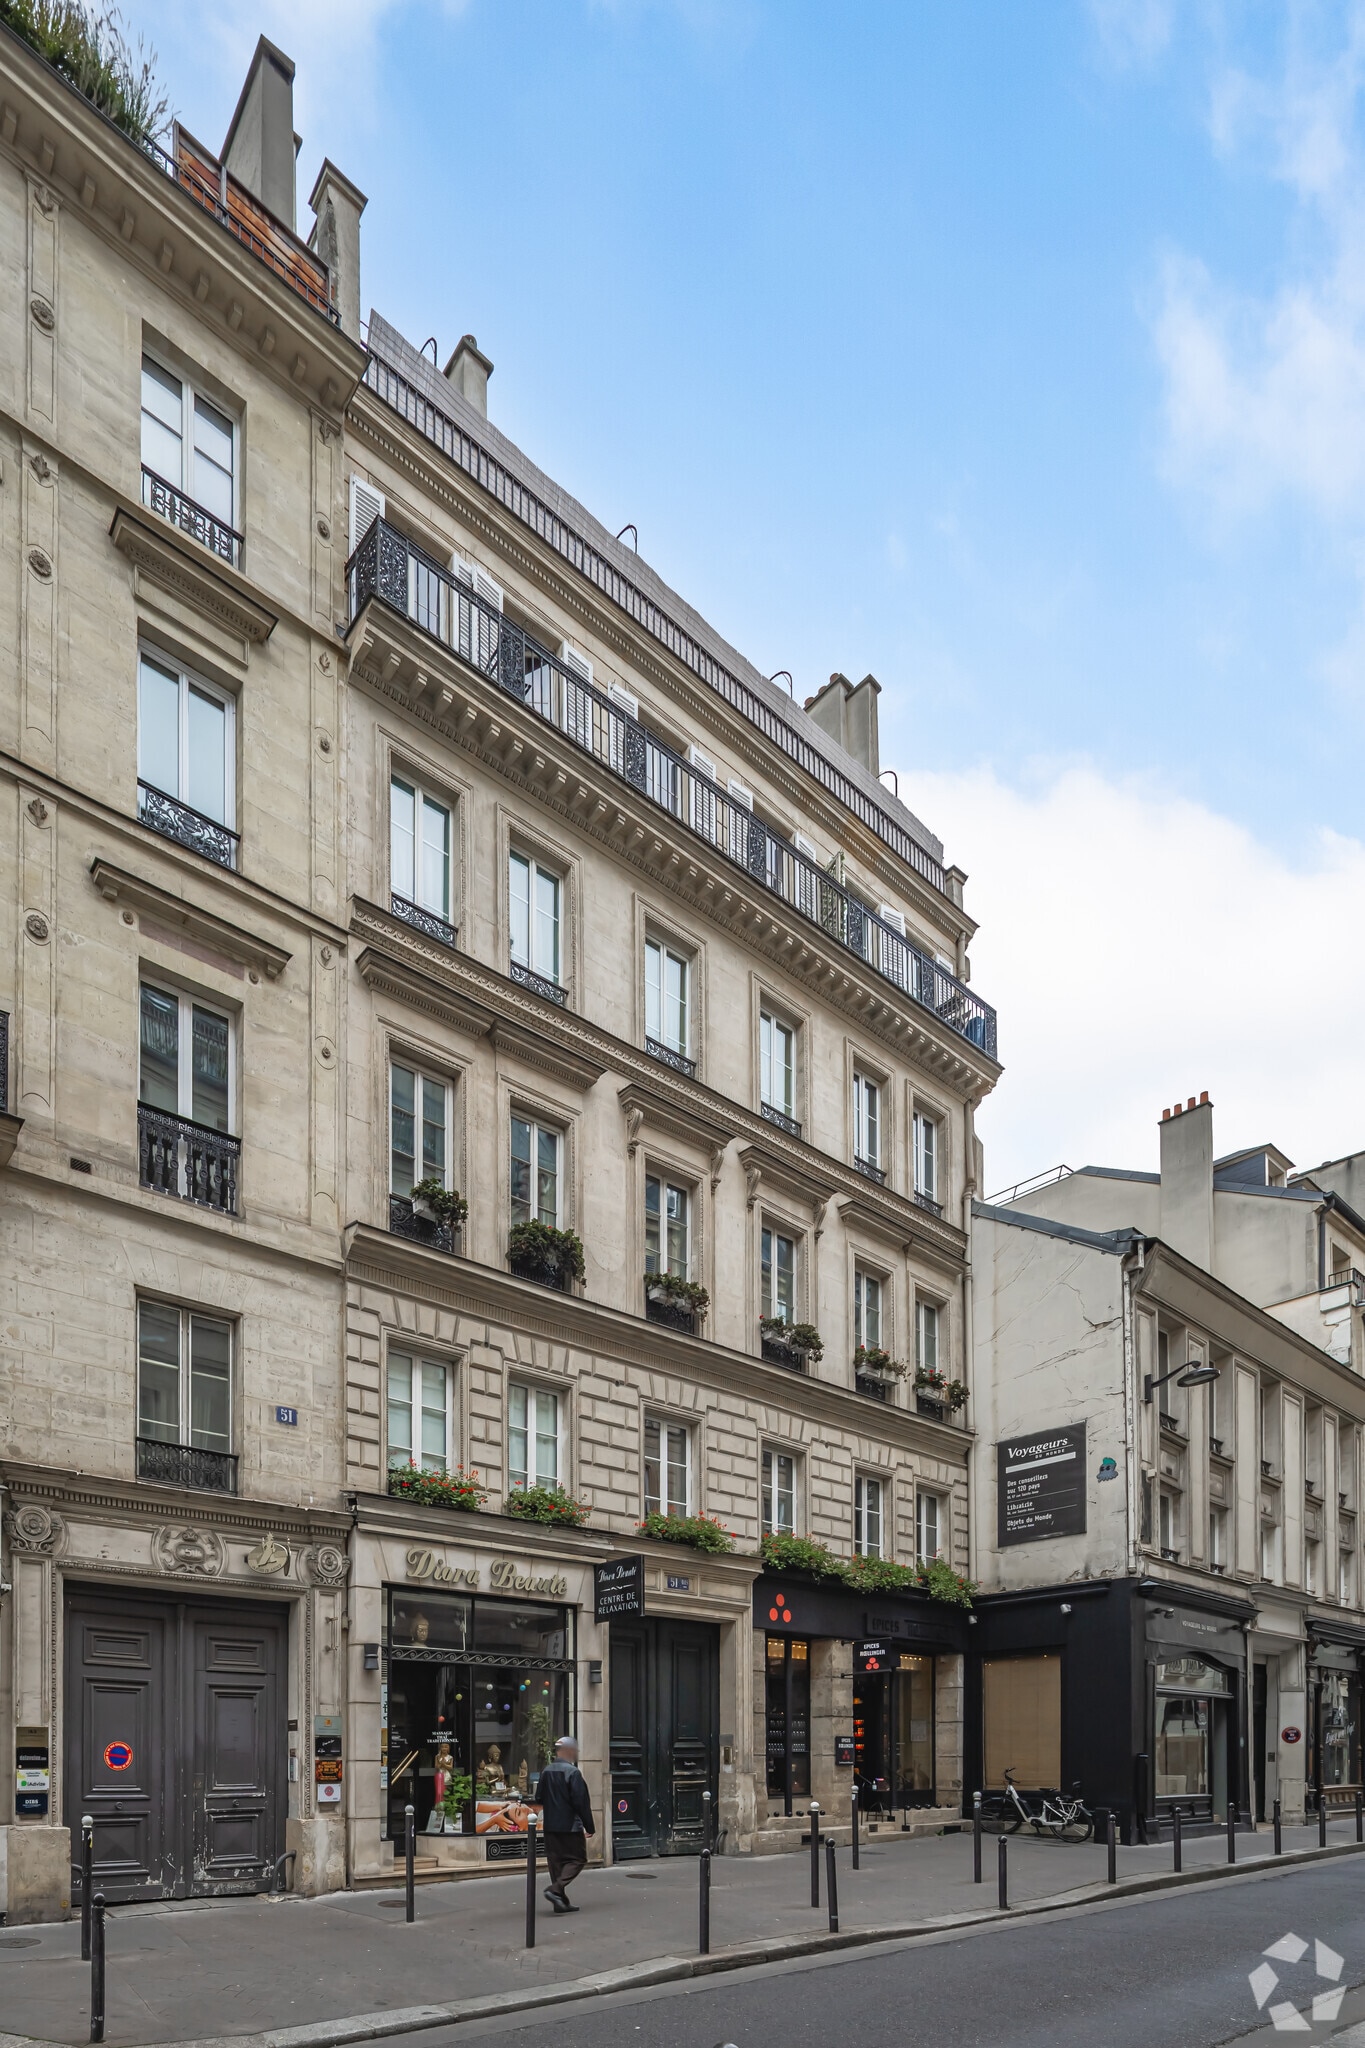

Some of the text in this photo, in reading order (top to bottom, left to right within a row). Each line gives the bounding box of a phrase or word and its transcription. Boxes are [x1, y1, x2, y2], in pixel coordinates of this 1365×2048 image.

[280, 1408, 293, 1423] 51
[1008, 1438, 1068, 1459] Voyageurs
[1045, 1448, 1065, 1457] MONDE
[1018, 1474, 1048, 1485] conseillers
[1028, 1483, 1040, 1491] pays
[1007, 1501, 1033, 1511] Librairie
[1006, 1518, 1025, 1527] Objets
[1034, 1513, 1052, 1521] Monde
[406, 1547, 568, 1595] Diora Beauté
[598, 1568, 615, 1583] Diora
[670, 1577, 678, 1588] 51
[600, 1591, 636, 1606] CENTRE DE
[598, 1601, 639, 1615] RELAXATION
[872, 1618, 900, 1633] EPICES
[863, 1642, 880, 1650] EPICES
